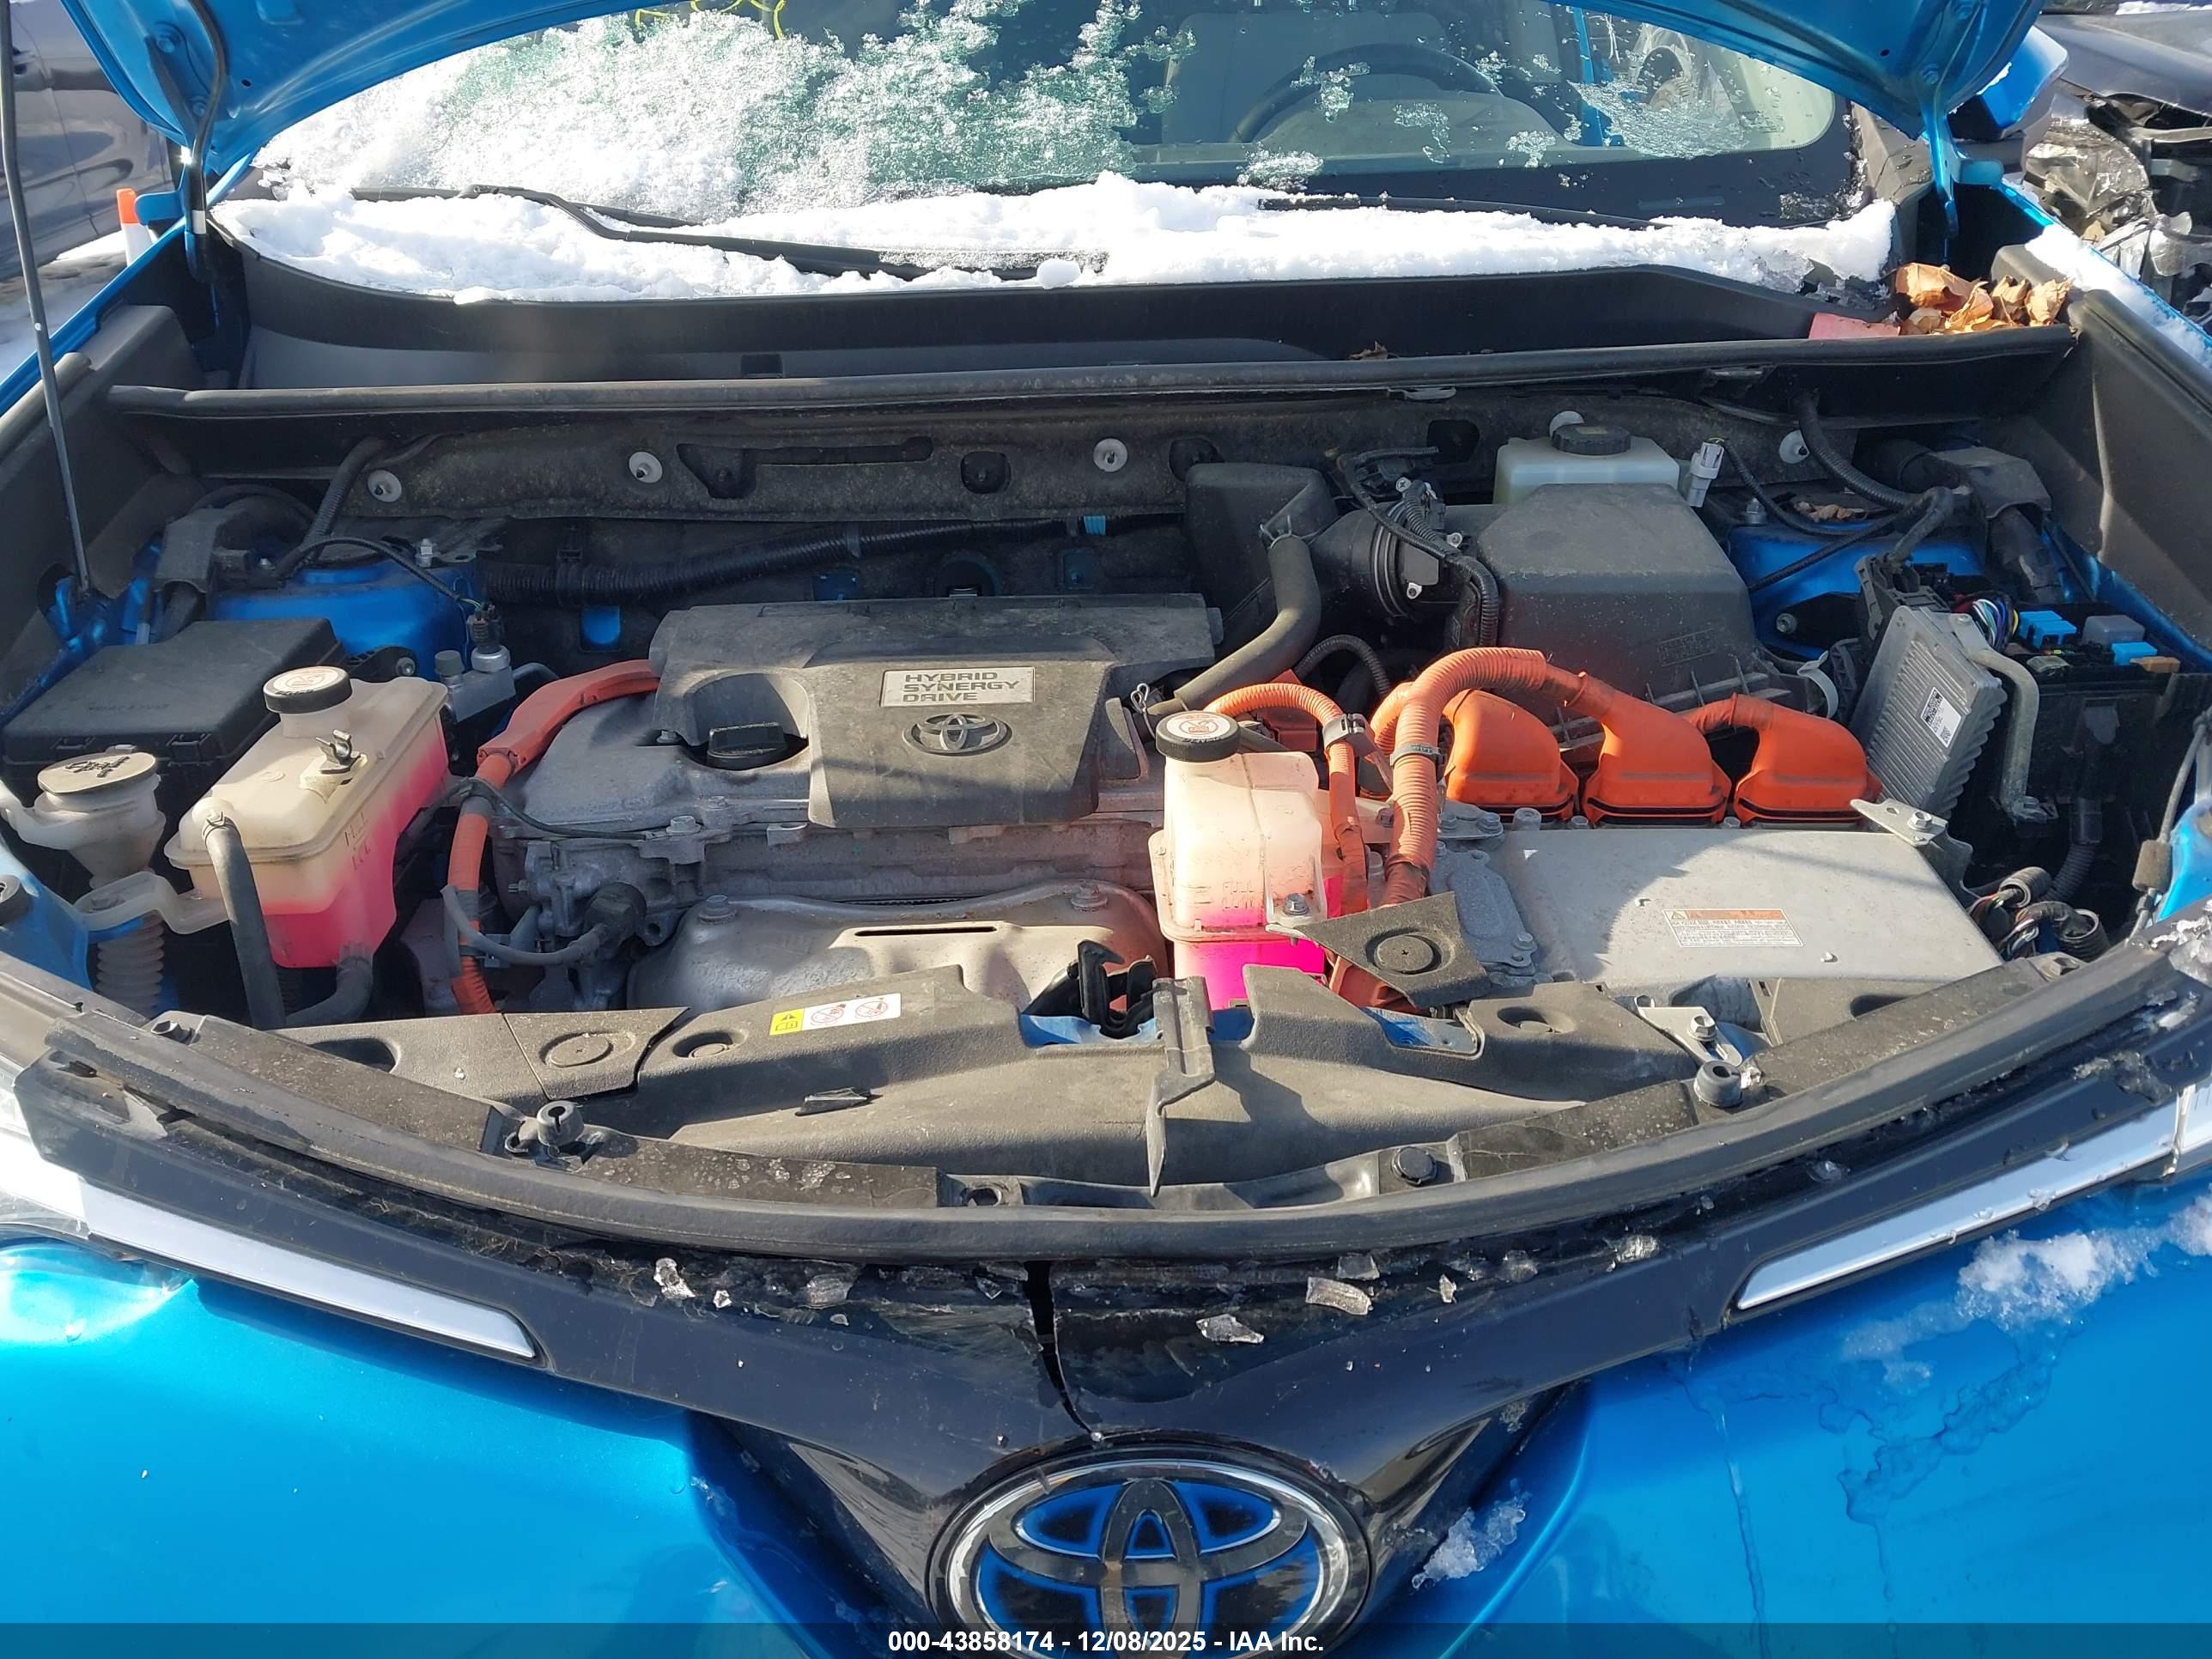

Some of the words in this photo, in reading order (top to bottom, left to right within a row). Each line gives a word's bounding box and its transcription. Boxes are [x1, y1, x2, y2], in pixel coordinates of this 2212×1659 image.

[905, 672, 998, 683] HYBRID
[902, 681, 1019, 692] SYNERGY
[902, 692, 978, 702] DRIVE
